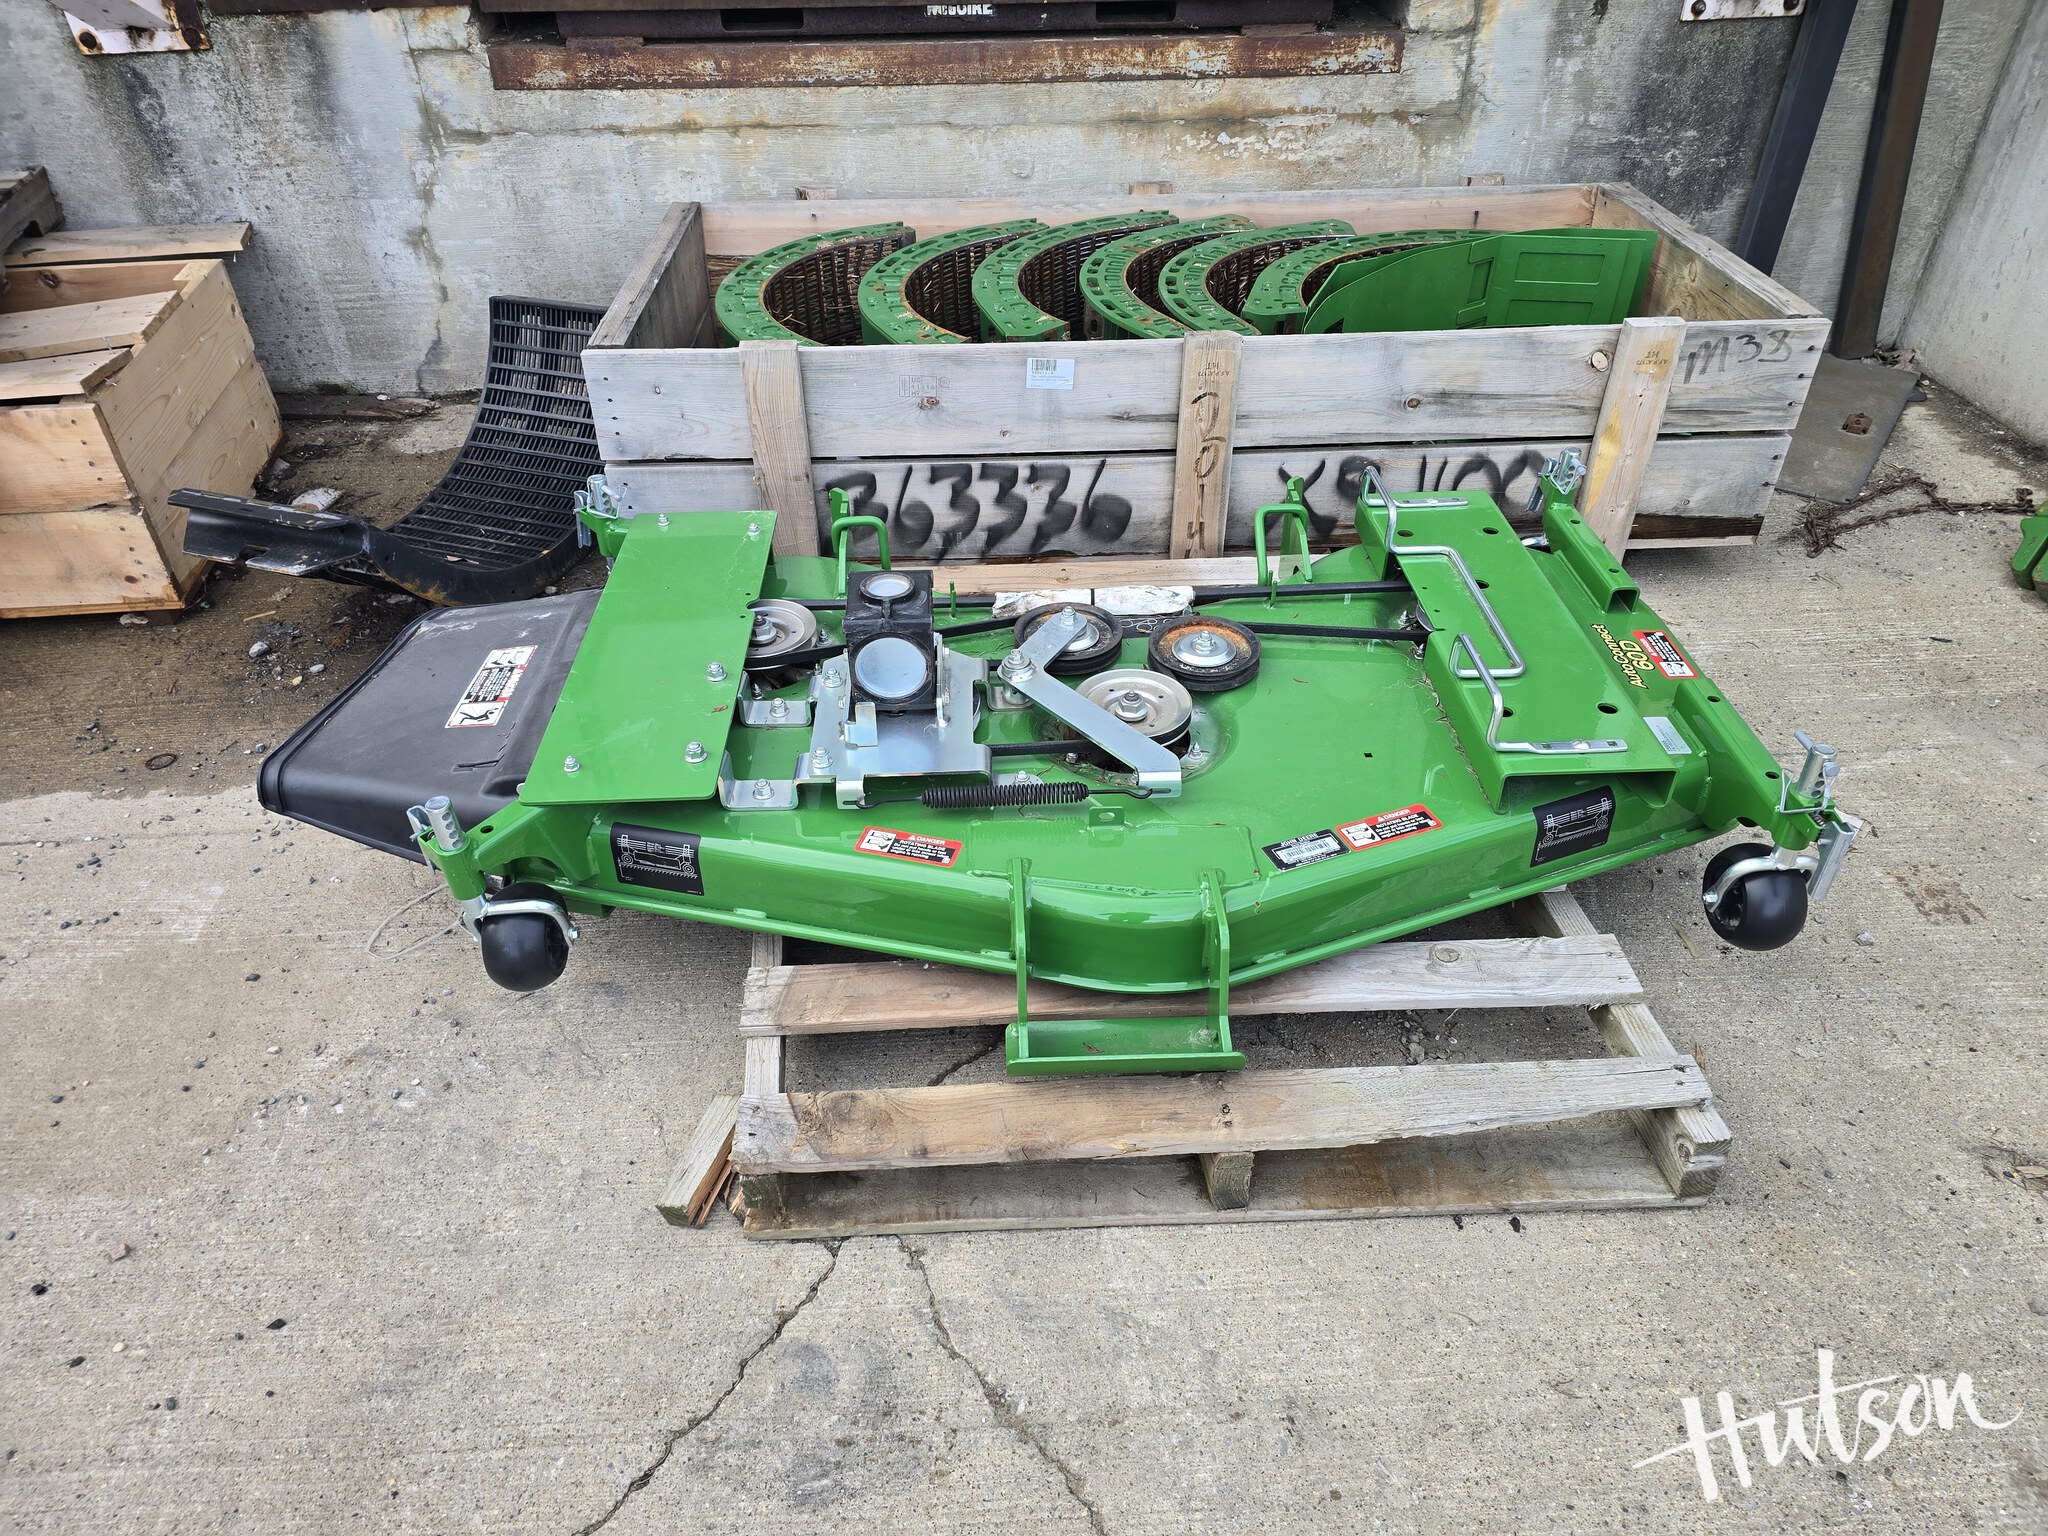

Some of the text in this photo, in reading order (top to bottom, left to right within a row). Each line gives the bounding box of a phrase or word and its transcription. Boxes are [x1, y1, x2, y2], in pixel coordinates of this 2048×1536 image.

[1590, 624, 1649, 690] AutoConnect
[1618, 639, 1656, 671] 60D
[1383, 808, 1411, 819] DANGER
[916, 836, 946, 845] DANGER
